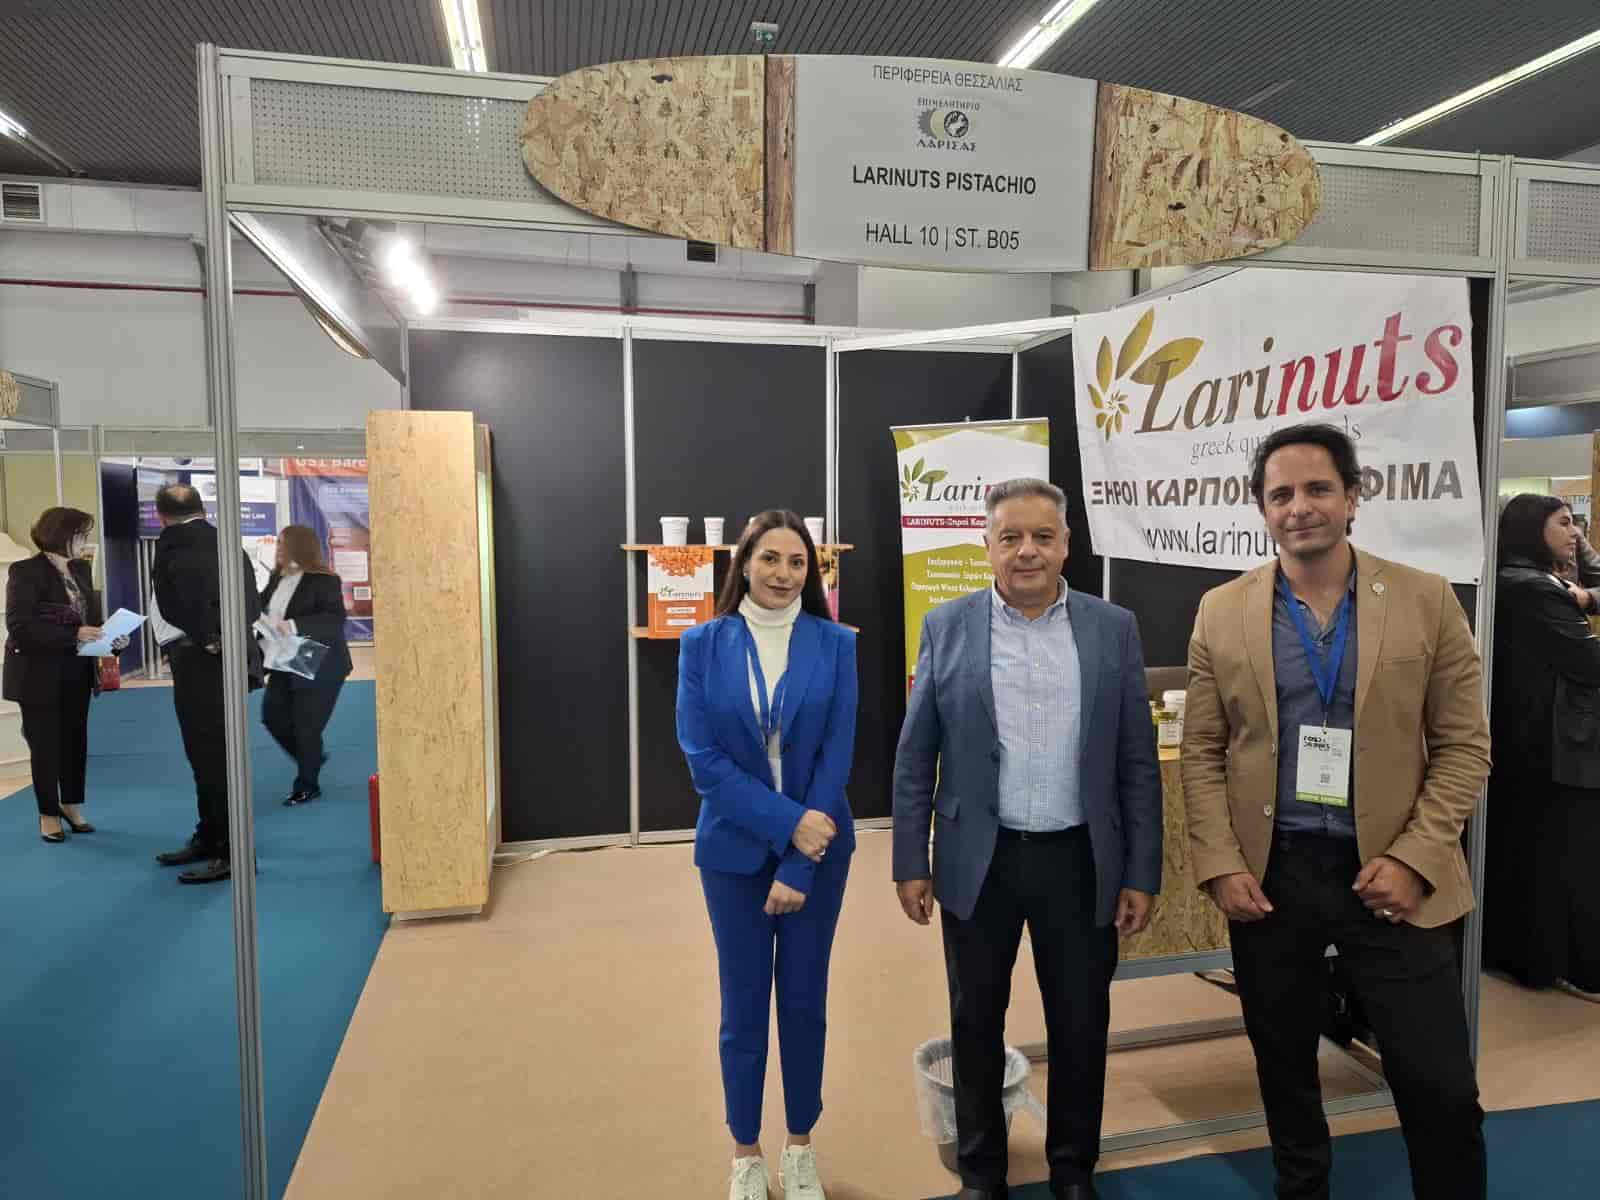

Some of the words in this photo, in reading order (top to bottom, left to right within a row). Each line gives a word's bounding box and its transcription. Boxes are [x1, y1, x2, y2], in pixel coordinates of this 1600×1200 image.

[873, 64, 952, 86] ΠΕΡΙΦΕΡΕΙΑ
[955, 72, 1023, 92] ΘΕΣΣΑΛΙΑΣ
[853, 165, 940, 189] LARINUTS
[946, 172, 1036, 195] PISTACHIO
[866, 223, 912, 244] HALL
[920, 226, 939, 245] 10
[955, 228, 981, 248] ST.
[987, 230, 1020, 249] B05
[1134, 311, 1463, 434] Larinuts
[1191, 431, 1235, 467] greek
[1091, 480, 1138, 506] ΞΗΡΟΙ
[1359, 460, 1463, 503] ΦΙΜΑ
